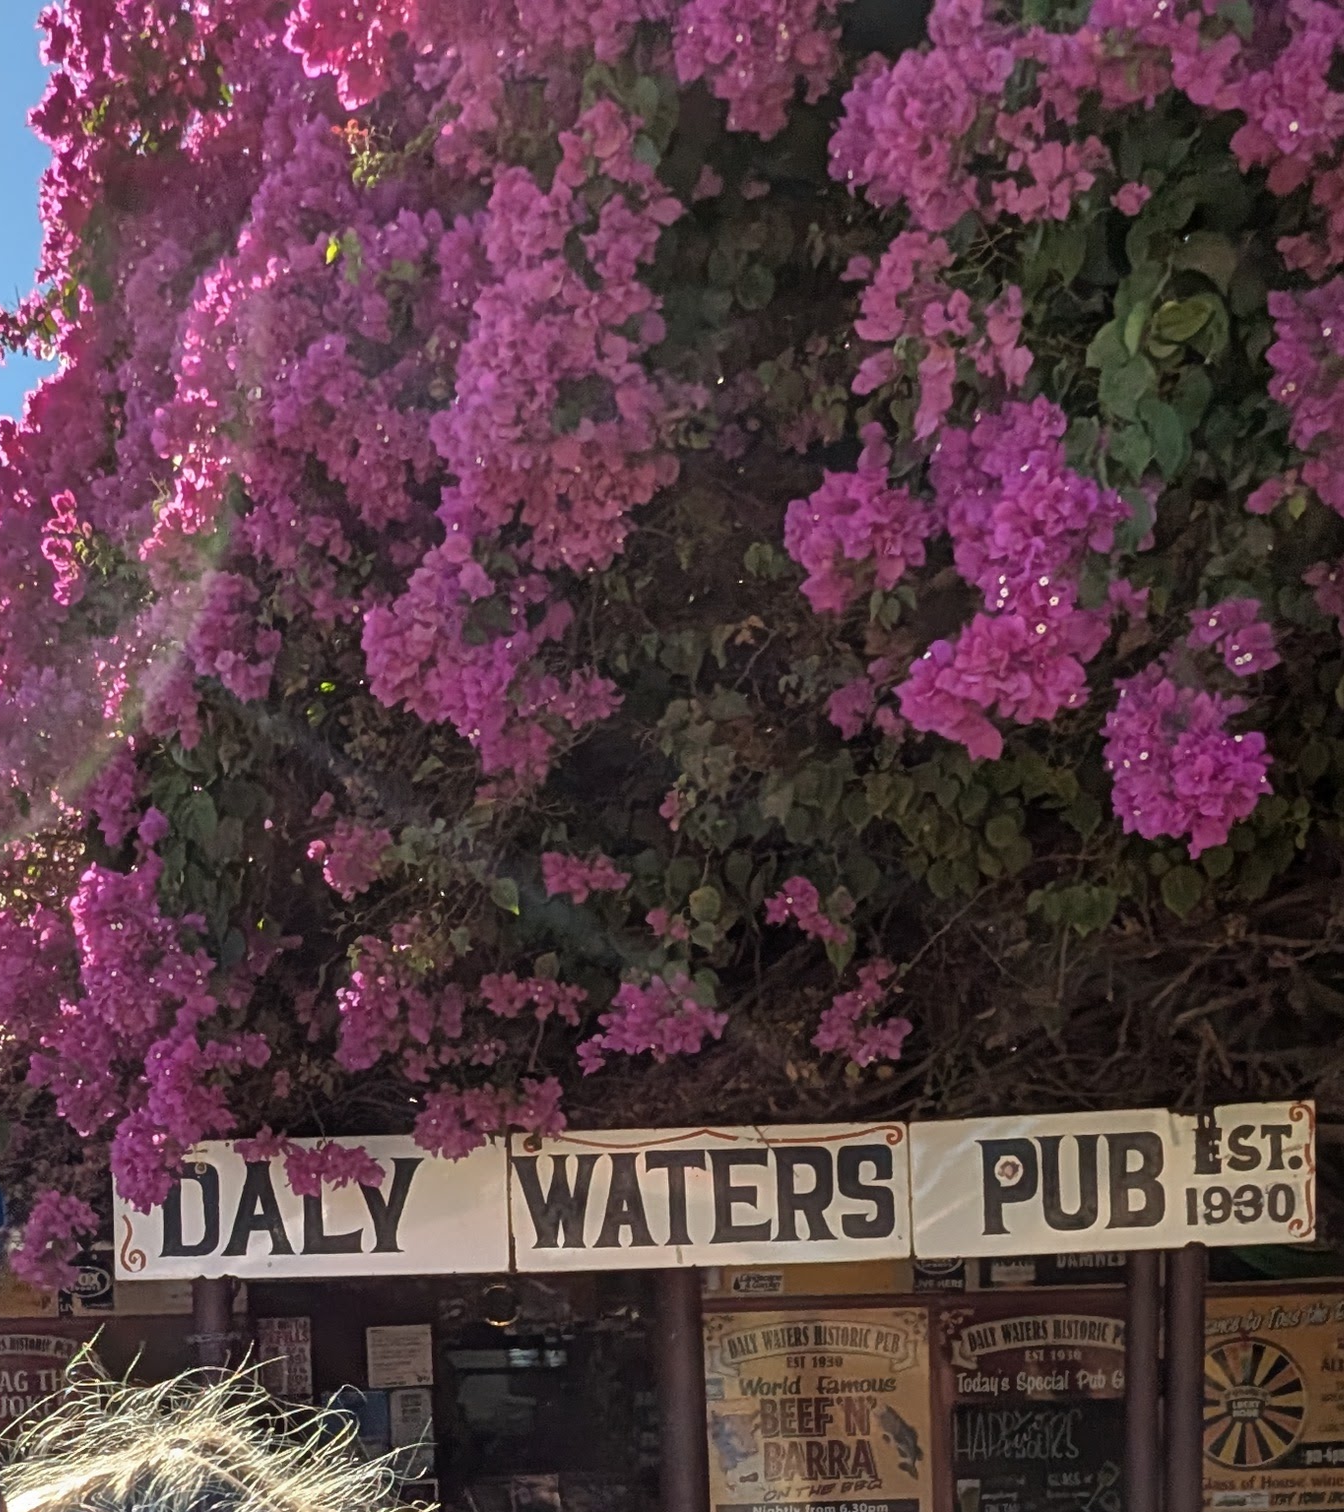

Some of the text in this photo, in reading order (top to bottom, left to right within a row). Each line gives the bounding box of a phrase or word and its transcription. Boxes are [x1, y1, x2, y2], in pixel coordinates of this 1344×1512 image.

[1193, 1123, 1303, 1175] EST.
[159, 1131, 1164, 1257] DALY WATERS PUB
[1186, 1183, 1295, 1227] 1930
[727, 1325, 901, 1359] DALY WATERS HISTORIC PUB
[968, 1327, 996, 1352] DALY
[1001, 1320, 1048, 1343] WATERS
[1053, 1319, 1111, 1342] HISTORIC
[786, 1356, 844, 1368] EST 1930
[36, 1369, 66, 1391] TH
[739, 1375, 897, 1396] World Famous
[956, 1368, 1010, 1396] Today's
[1016, 1369, 1069, 1394] Special
[1076, 1368, 1106, 1389] Pub
[763, 1439, 879, 1480] BARRA
[763, 1480, 883, 1502] ON THE BBQ
[1261, 1475, 1302, 1488] House
[1311, 1474, 1344, 1487] wine
